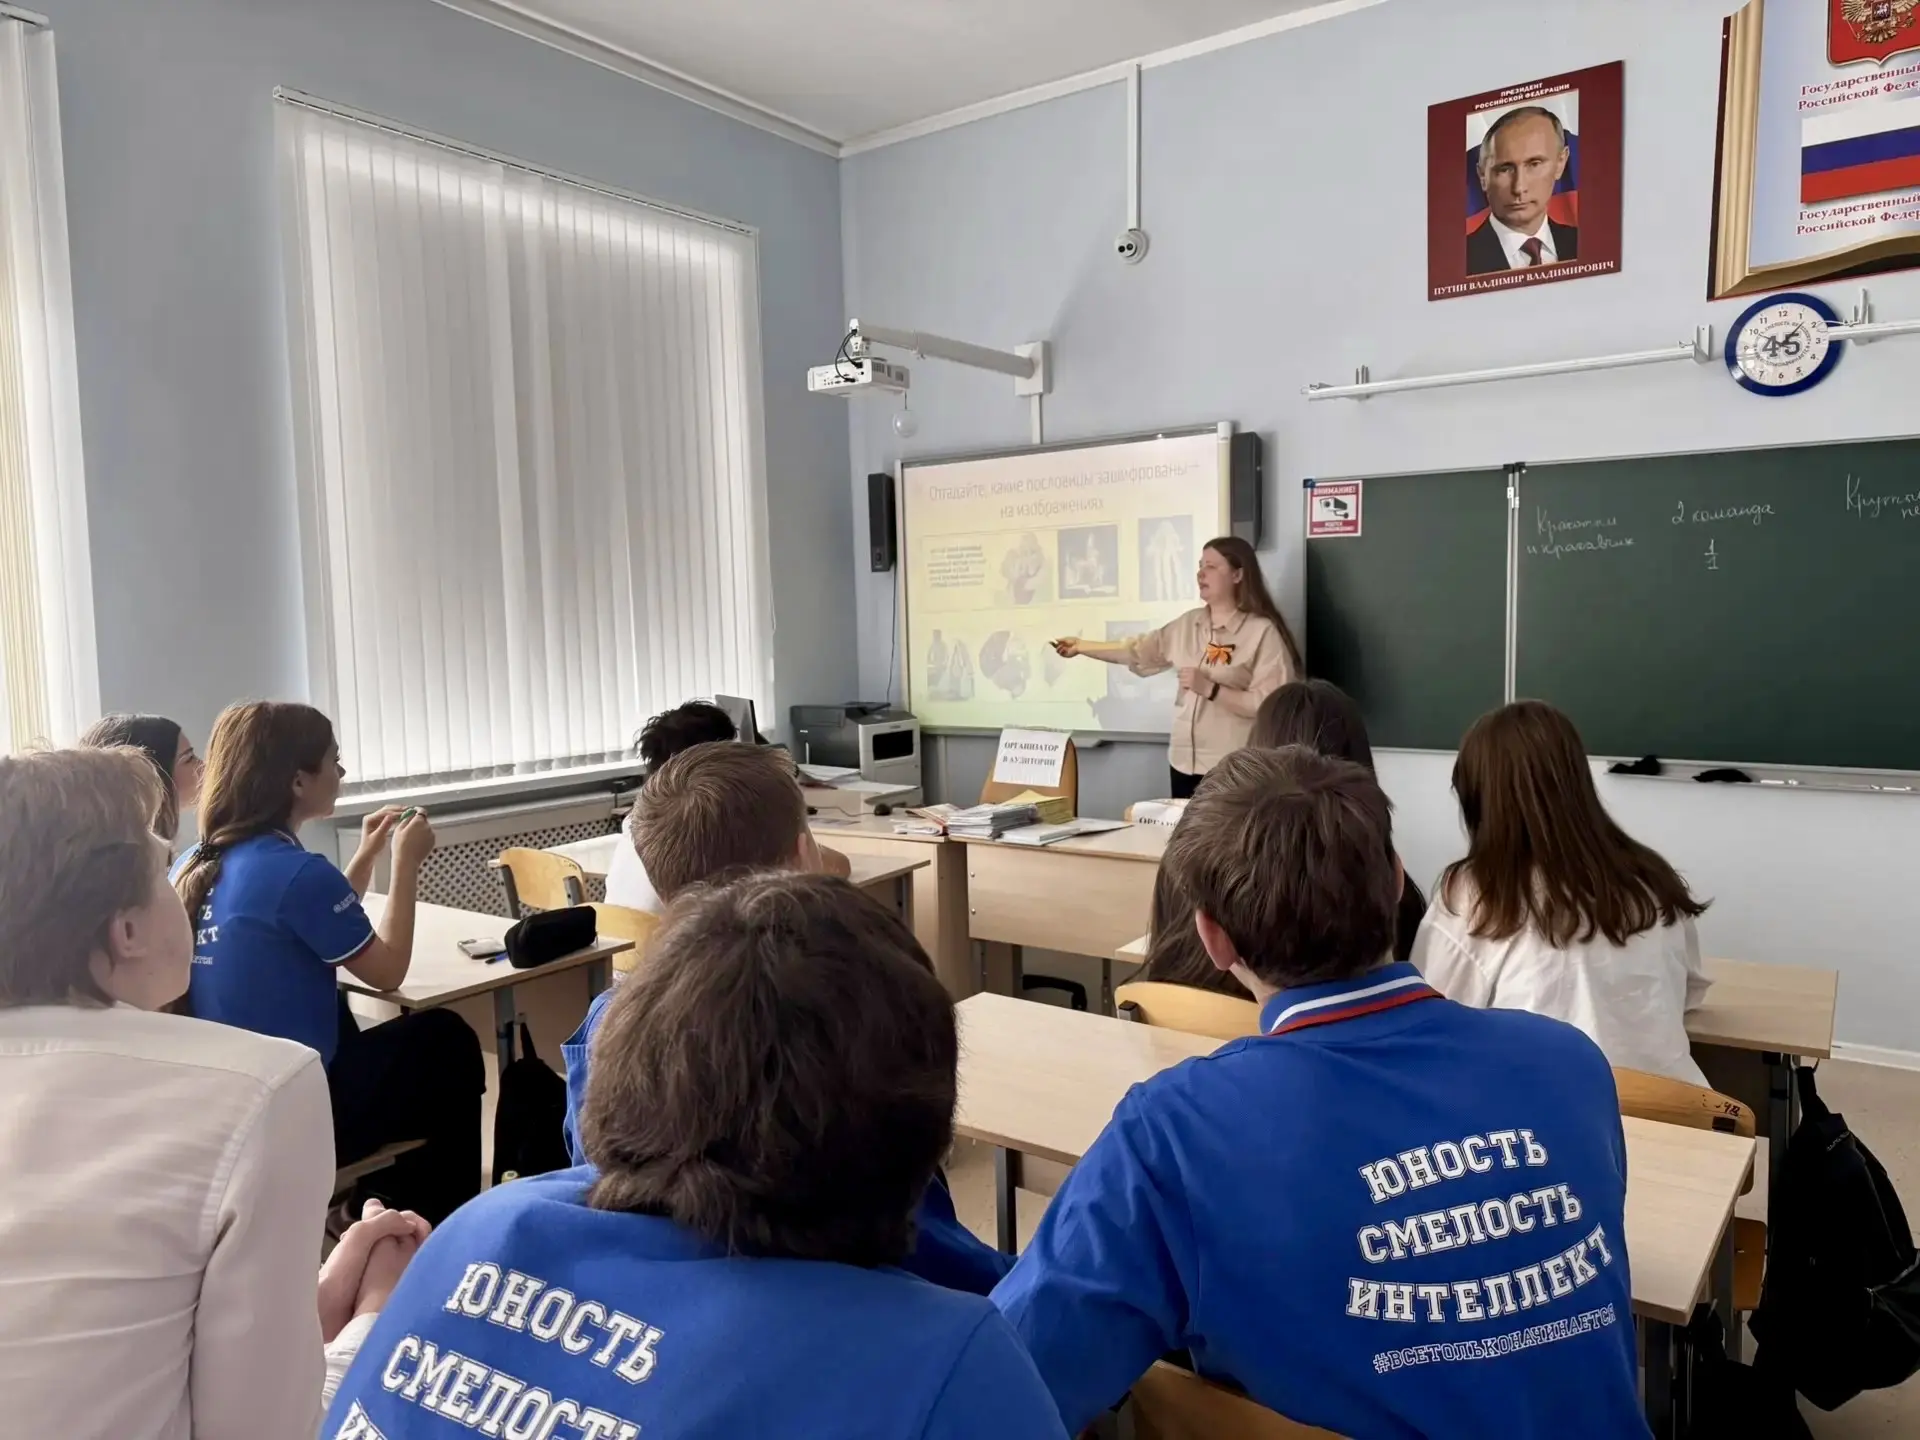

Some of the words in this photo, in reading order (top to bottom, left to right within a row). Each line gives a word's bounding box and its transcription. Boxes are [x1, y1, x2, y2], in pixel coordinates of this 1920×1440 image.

[1475, 94, 1523, 110] РОССИЙСКОЙ
[1525, 84, 1570, 99] ФЕДЕРАЦИИ
[1500, 83, 1543, 97] ПРЕЗИДЕНТ
[1798, 86, 1878, 111] Российской
[1796, 214, 1876, 235] Российской
[1433, 283, 1467, 296] ПУТИН
[1469, 274, 1525, 290] ВЛАДИМИР
[1526, 260, 1615, 281] ВЛАДИМИРОВИЧ
[990, 478, 1024, 496] какие
[1027, 473, 1093, 494] пословицы
[1000, 504, 1014, 519] на
[1672, 500, 1685, 525] 2
[1692, 503, 1776, 526] команда
[1004, 741, 1060, 752] ОРГАНИЗАТОР
[1002, 755, 1008, 763] В
[1010, 756, 1056, 767] АУДИТОРИИ
[1358, 1128, 1549, 1204] ЮНОСТЬ
[1356, 1182, 1583, 1264] СМЕЛОСТЬ
[1345, 1222, 1613, 1323] ИНТЕЛЛЕКТ
[442, 1260, 665, 1386] ЮНОСТЬ
[1373, 1303, 1616, 1375] #ВСЕТОЛЬКОНАЧИНАЕТСЯ
[380, 1333, 642, 1440] СМЕЛОСТ
